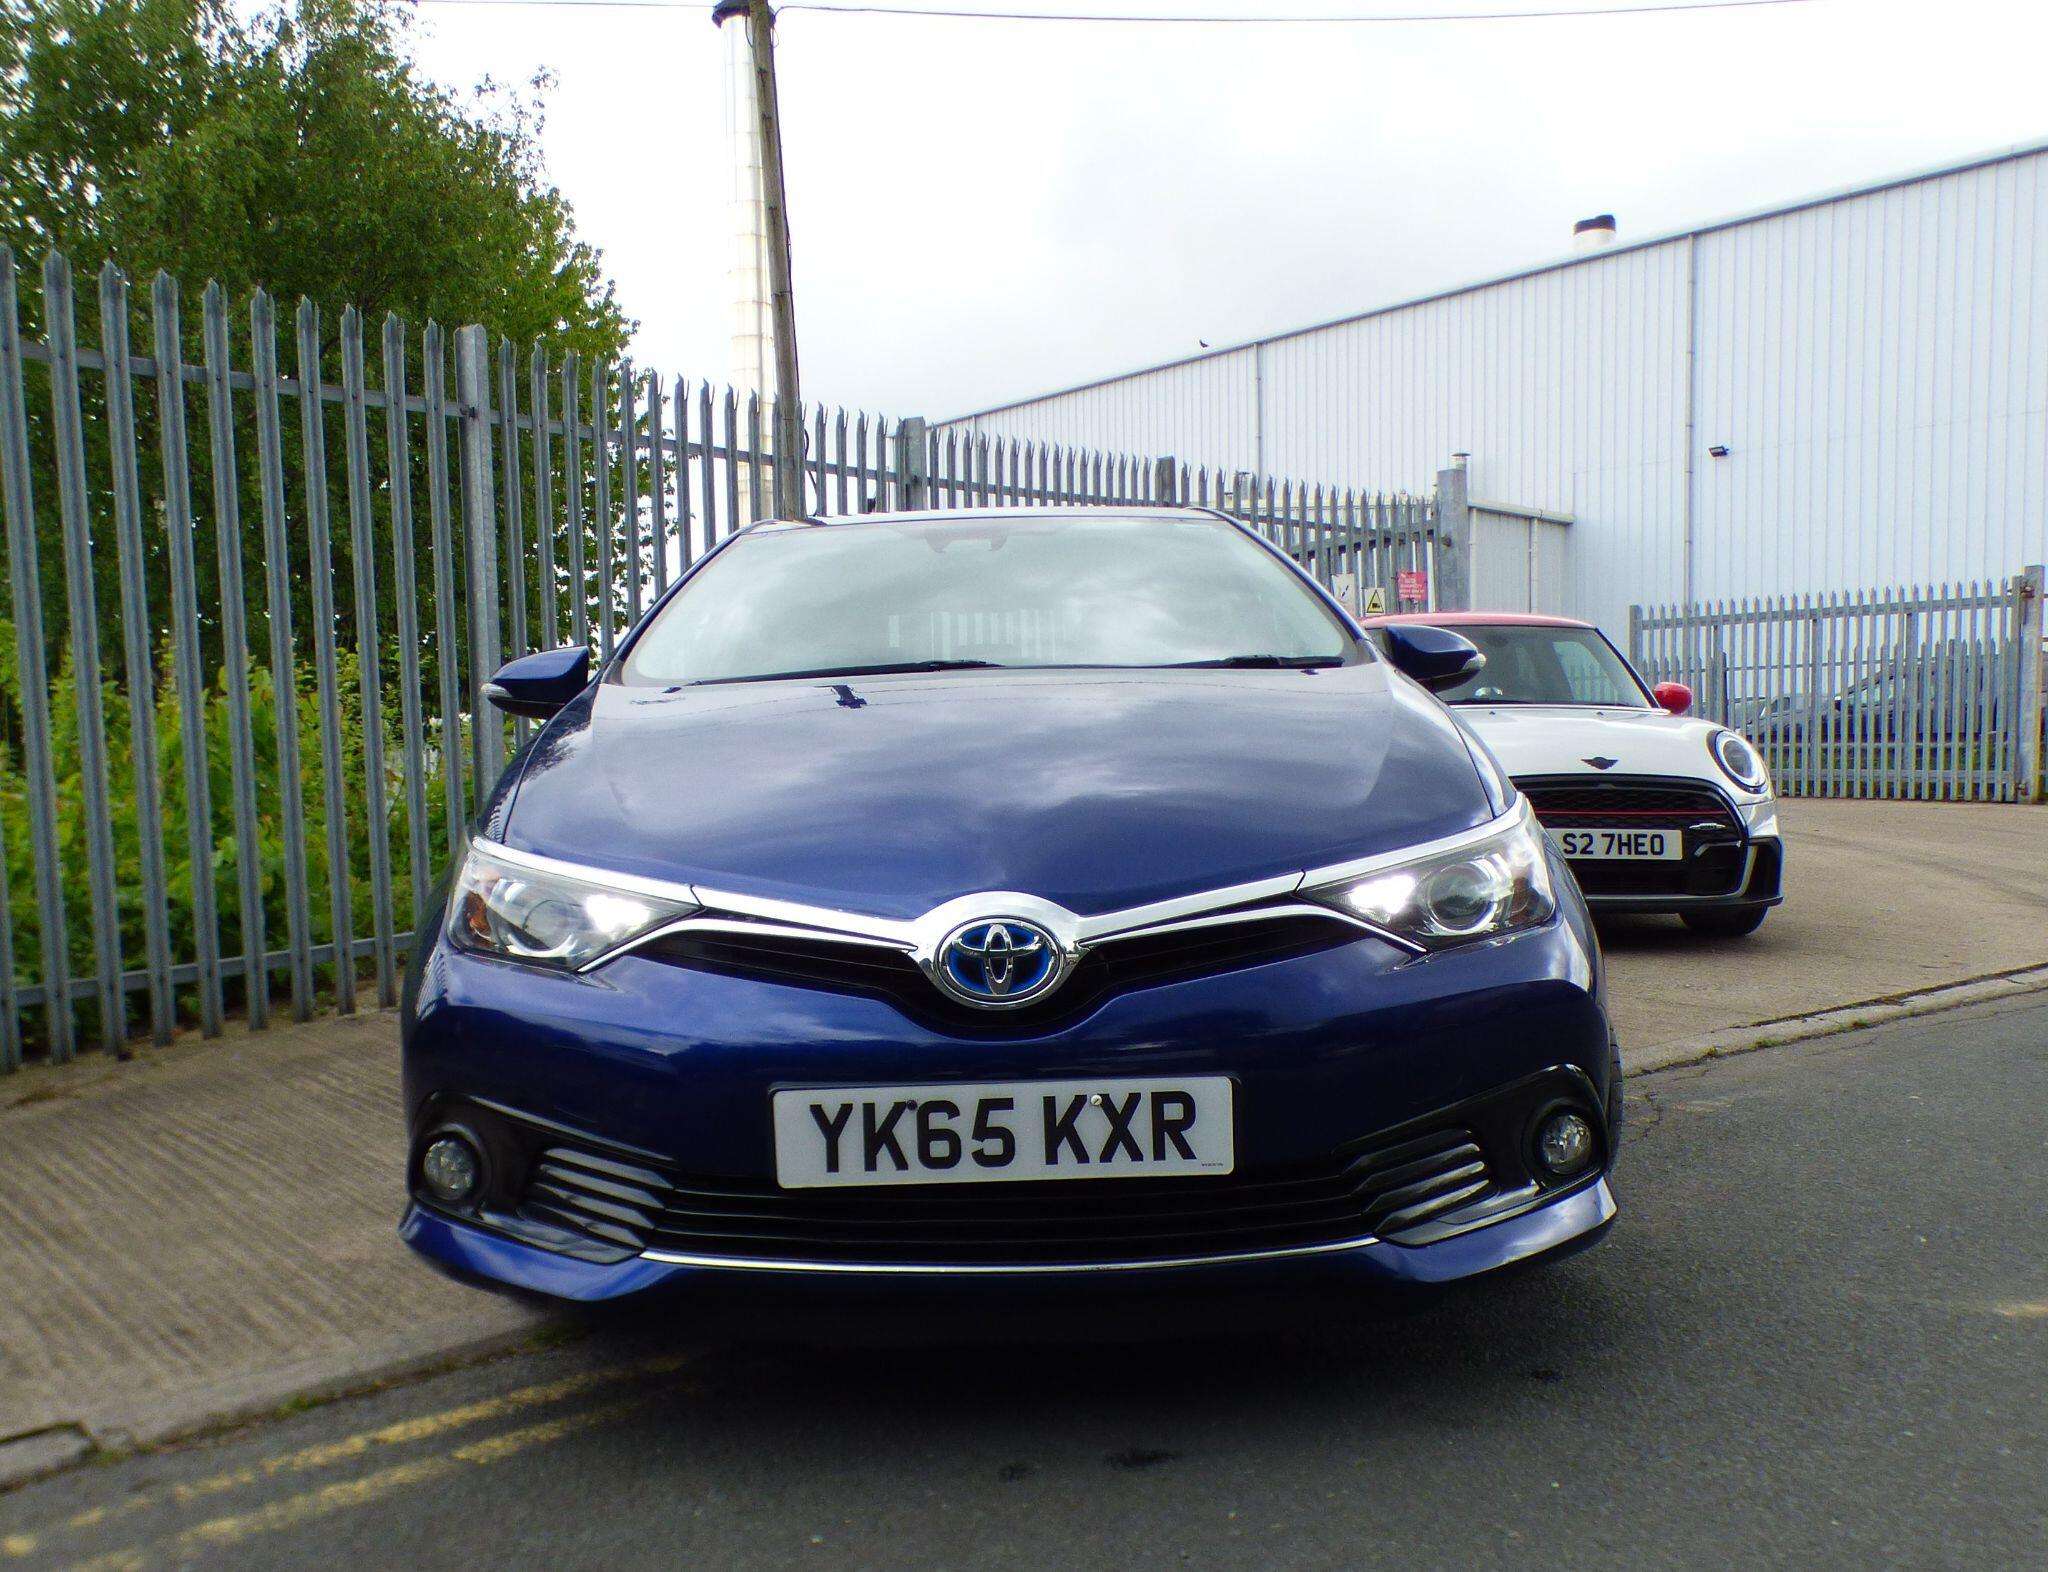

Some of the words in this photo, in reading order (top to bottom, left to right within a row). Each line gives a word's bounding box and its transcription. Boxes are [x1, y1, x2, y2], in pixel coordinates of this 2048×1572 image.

[1562, 832, 1594, 856] S2
[809, 1096, 1016, 1174] YK65
[1043, 1090, 1197, 1166] KXR
